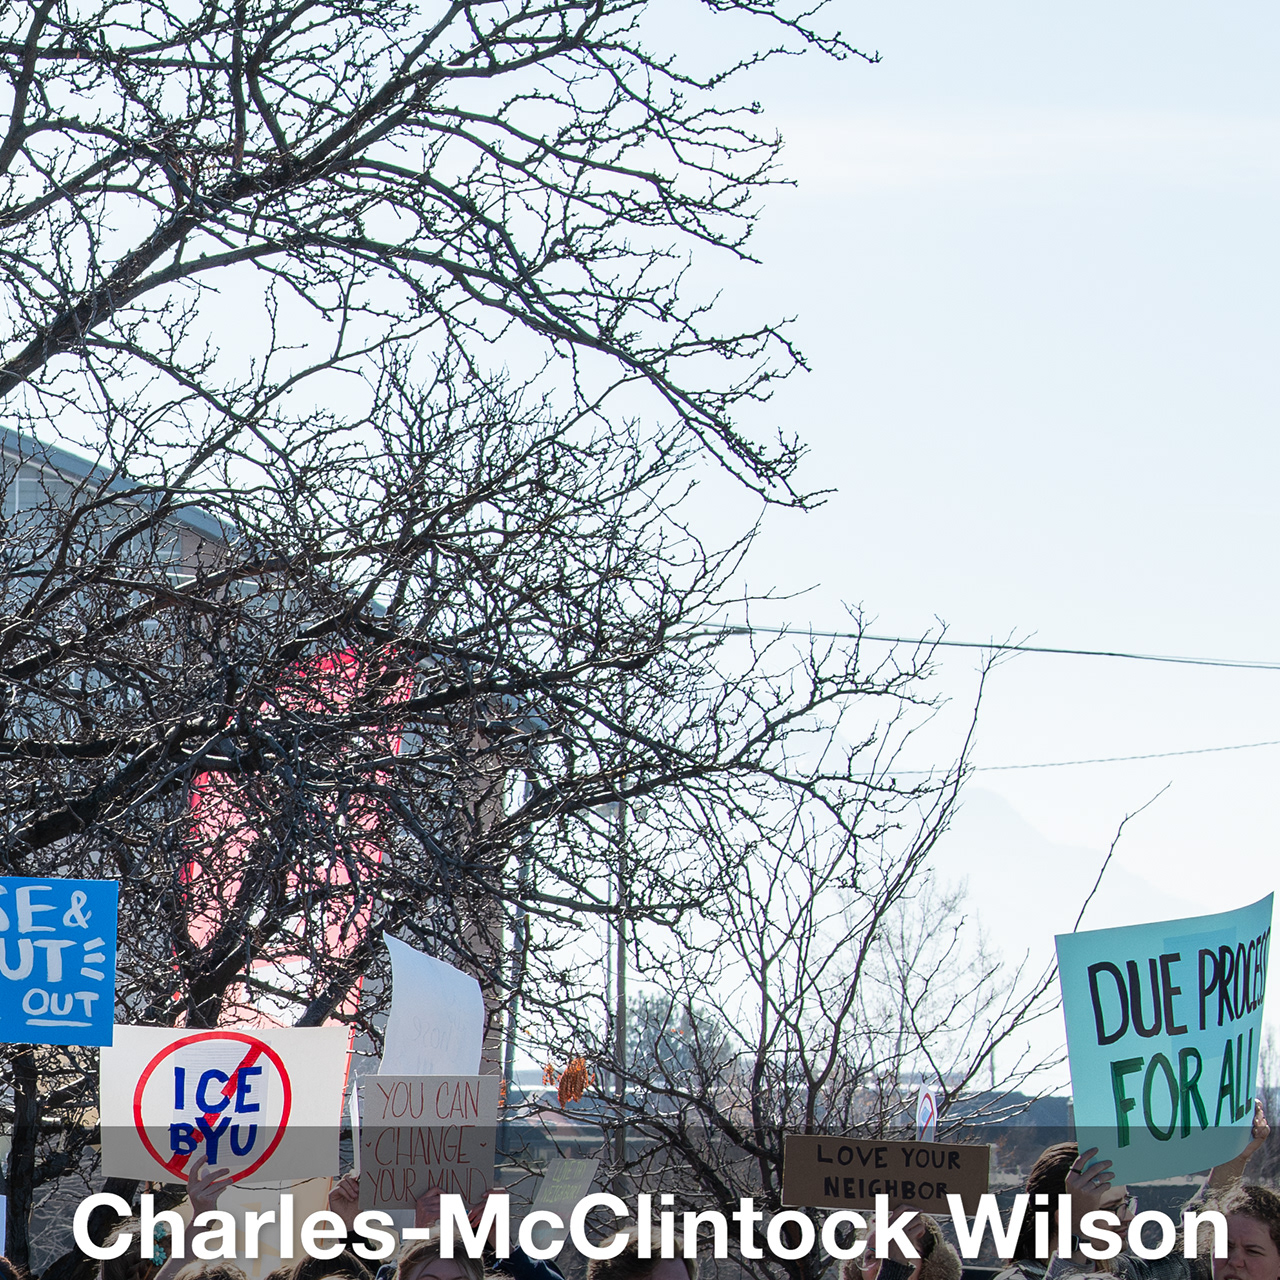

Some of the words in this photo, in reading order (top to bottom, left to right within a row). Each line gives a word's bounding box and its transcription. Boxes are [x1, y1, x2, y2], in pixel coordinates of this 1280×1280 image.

[62, 890, 93, 931] &
[22, 988, 101, 1018] OUT
[1087, 953, 1188, 1045] DUE
[1198, 926, 1272, 1031] PROCESS
[175, 1065, 263, 1114] ICE
[377, 1081, 425, 1119] YOU
[436, 1080, 481, 1120] CAN
[1110, 1047, 1209, 1148] FOR
[1215, 1027, 1254, 1128] ALL
[168, 1116, 258, 1165] BYU
[374, 1123, 476, 1166] CHANGE
[817, 1144, 888, 1169] LOVE
[901, 1147, 961, 1170] YOUR
[367, 1168, 418, 1207] YOUR
[428, 1167, 487, 1206] MIND
[824, 1175, 948, 1200] NEIGHBOR
